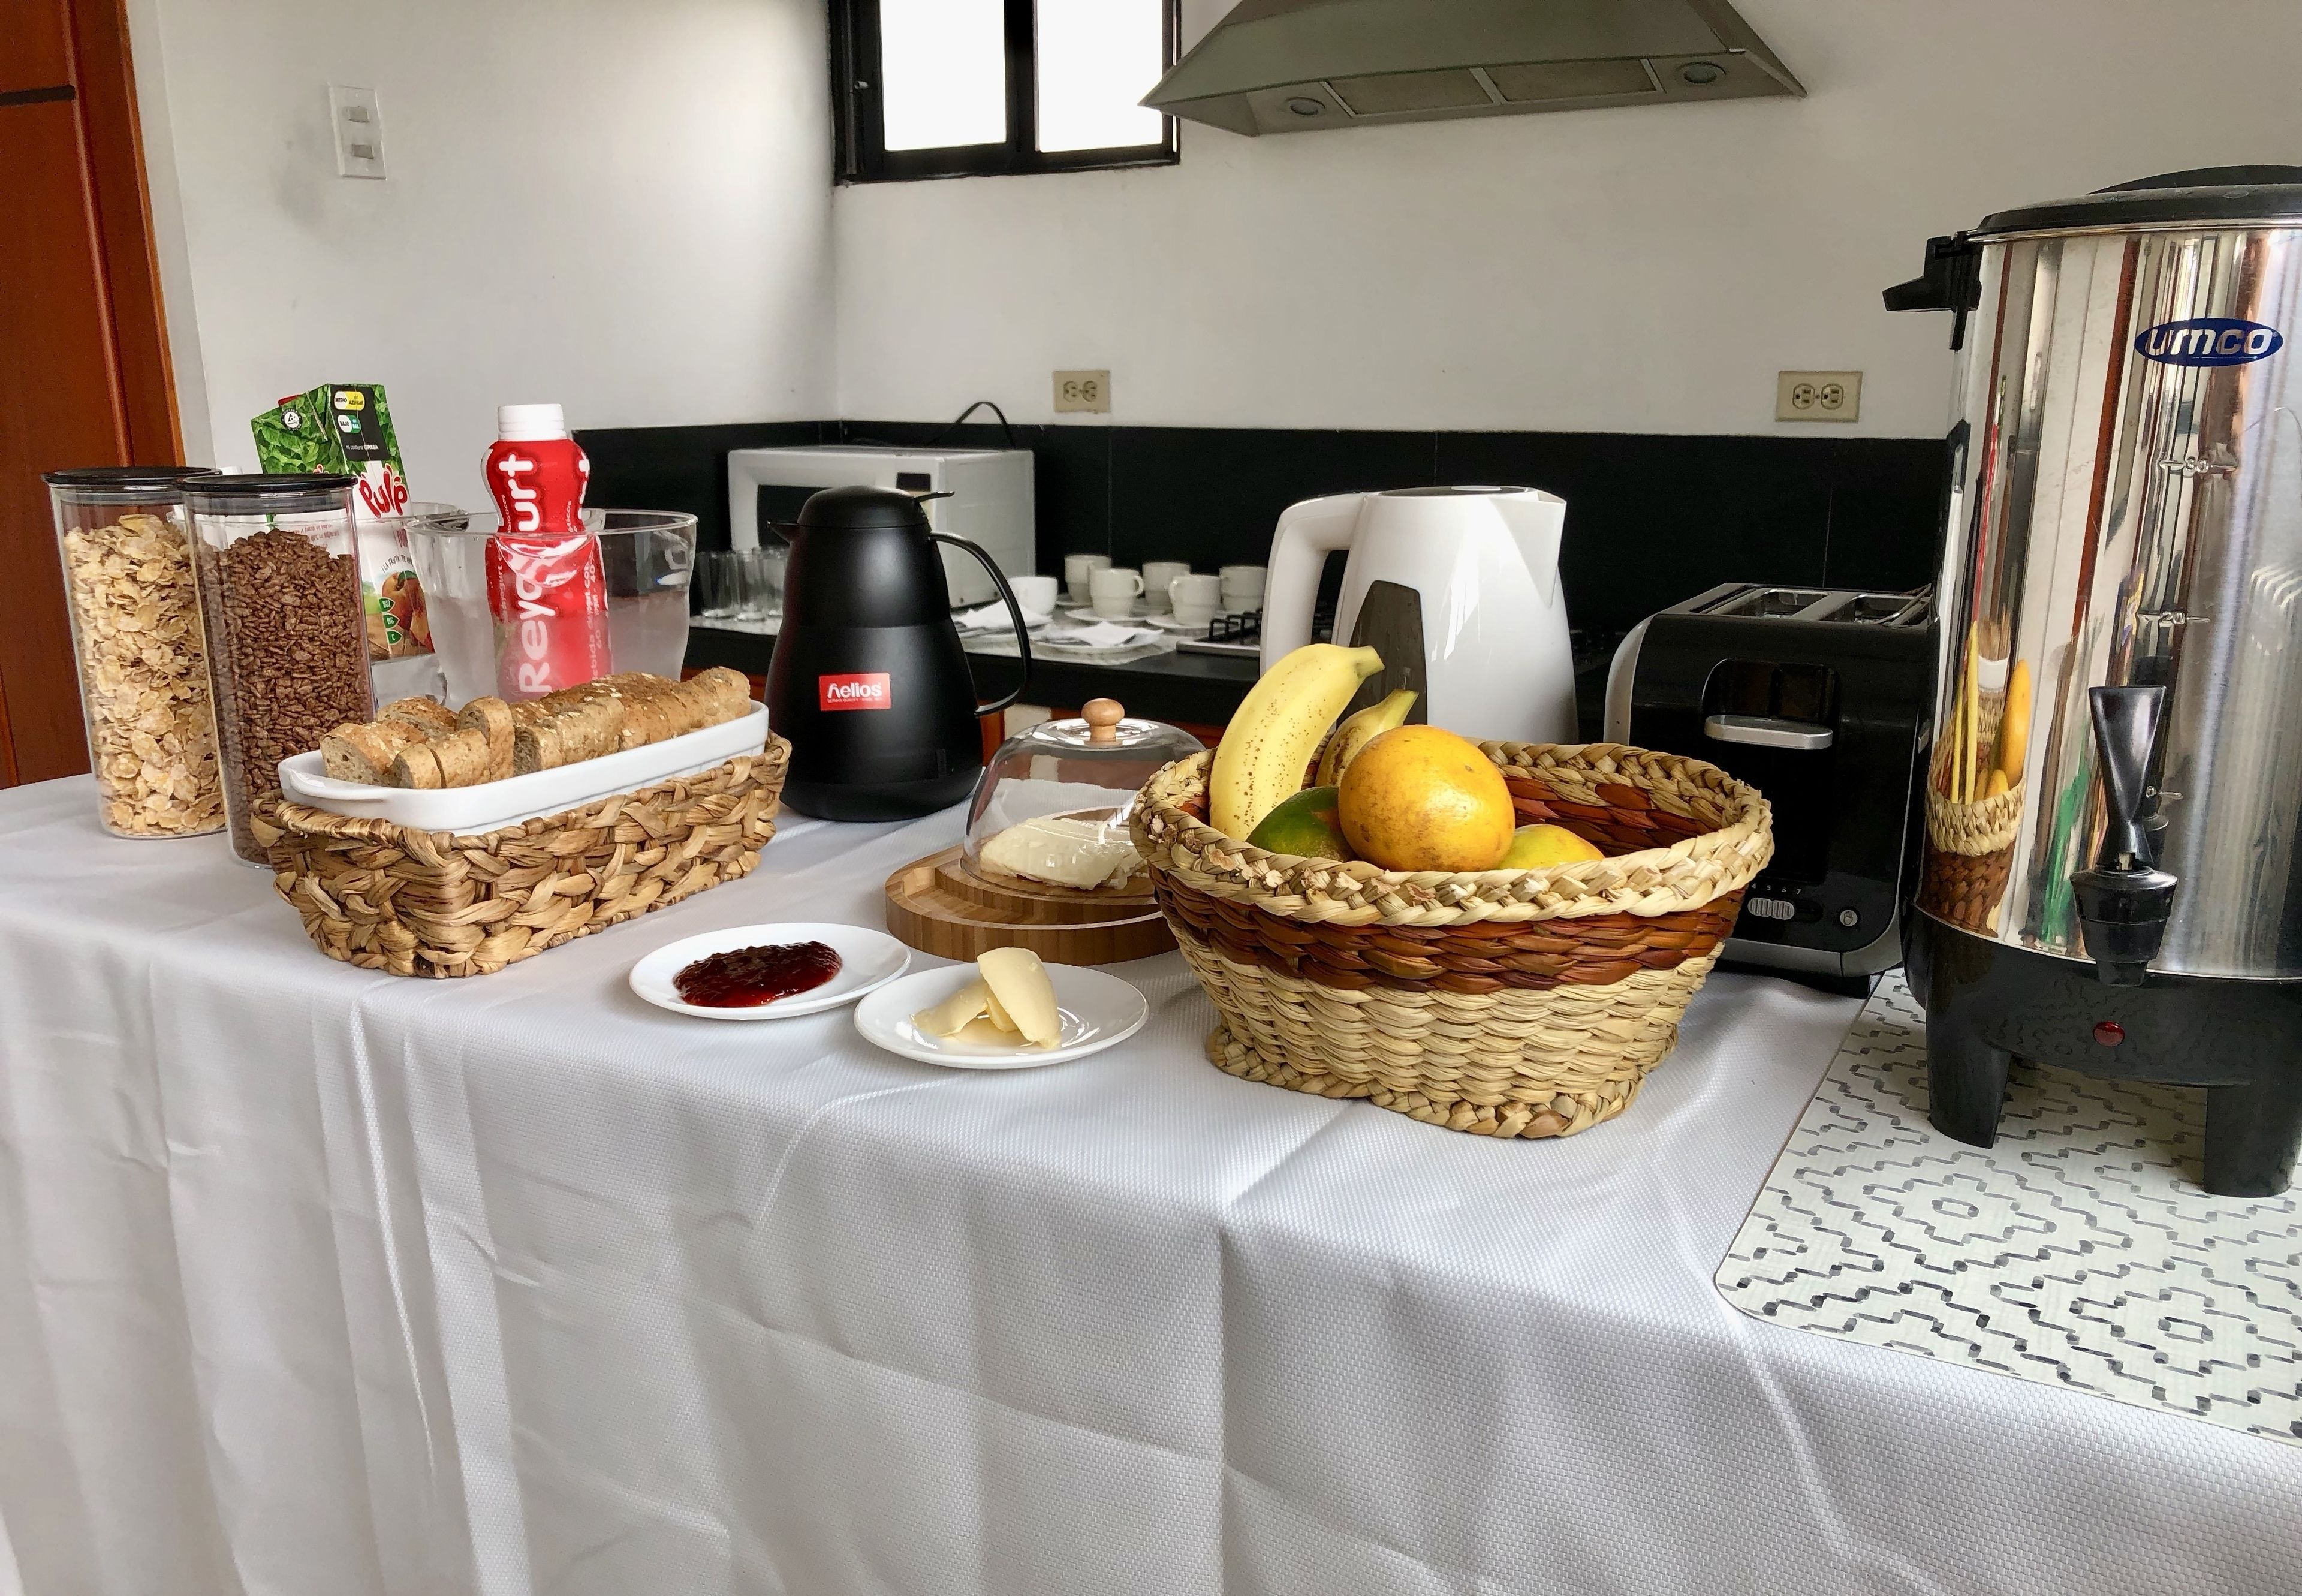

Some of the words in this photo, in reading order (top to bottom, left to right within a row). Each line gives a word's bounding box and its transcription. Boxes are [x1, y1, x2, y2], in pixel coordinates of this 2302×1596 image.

[2144, 328, 2273, 356] umco
[358, 466, 408, 519] Pulp
[387, 616, 394, 625] B6
[827, 682, 882, 699] helios
